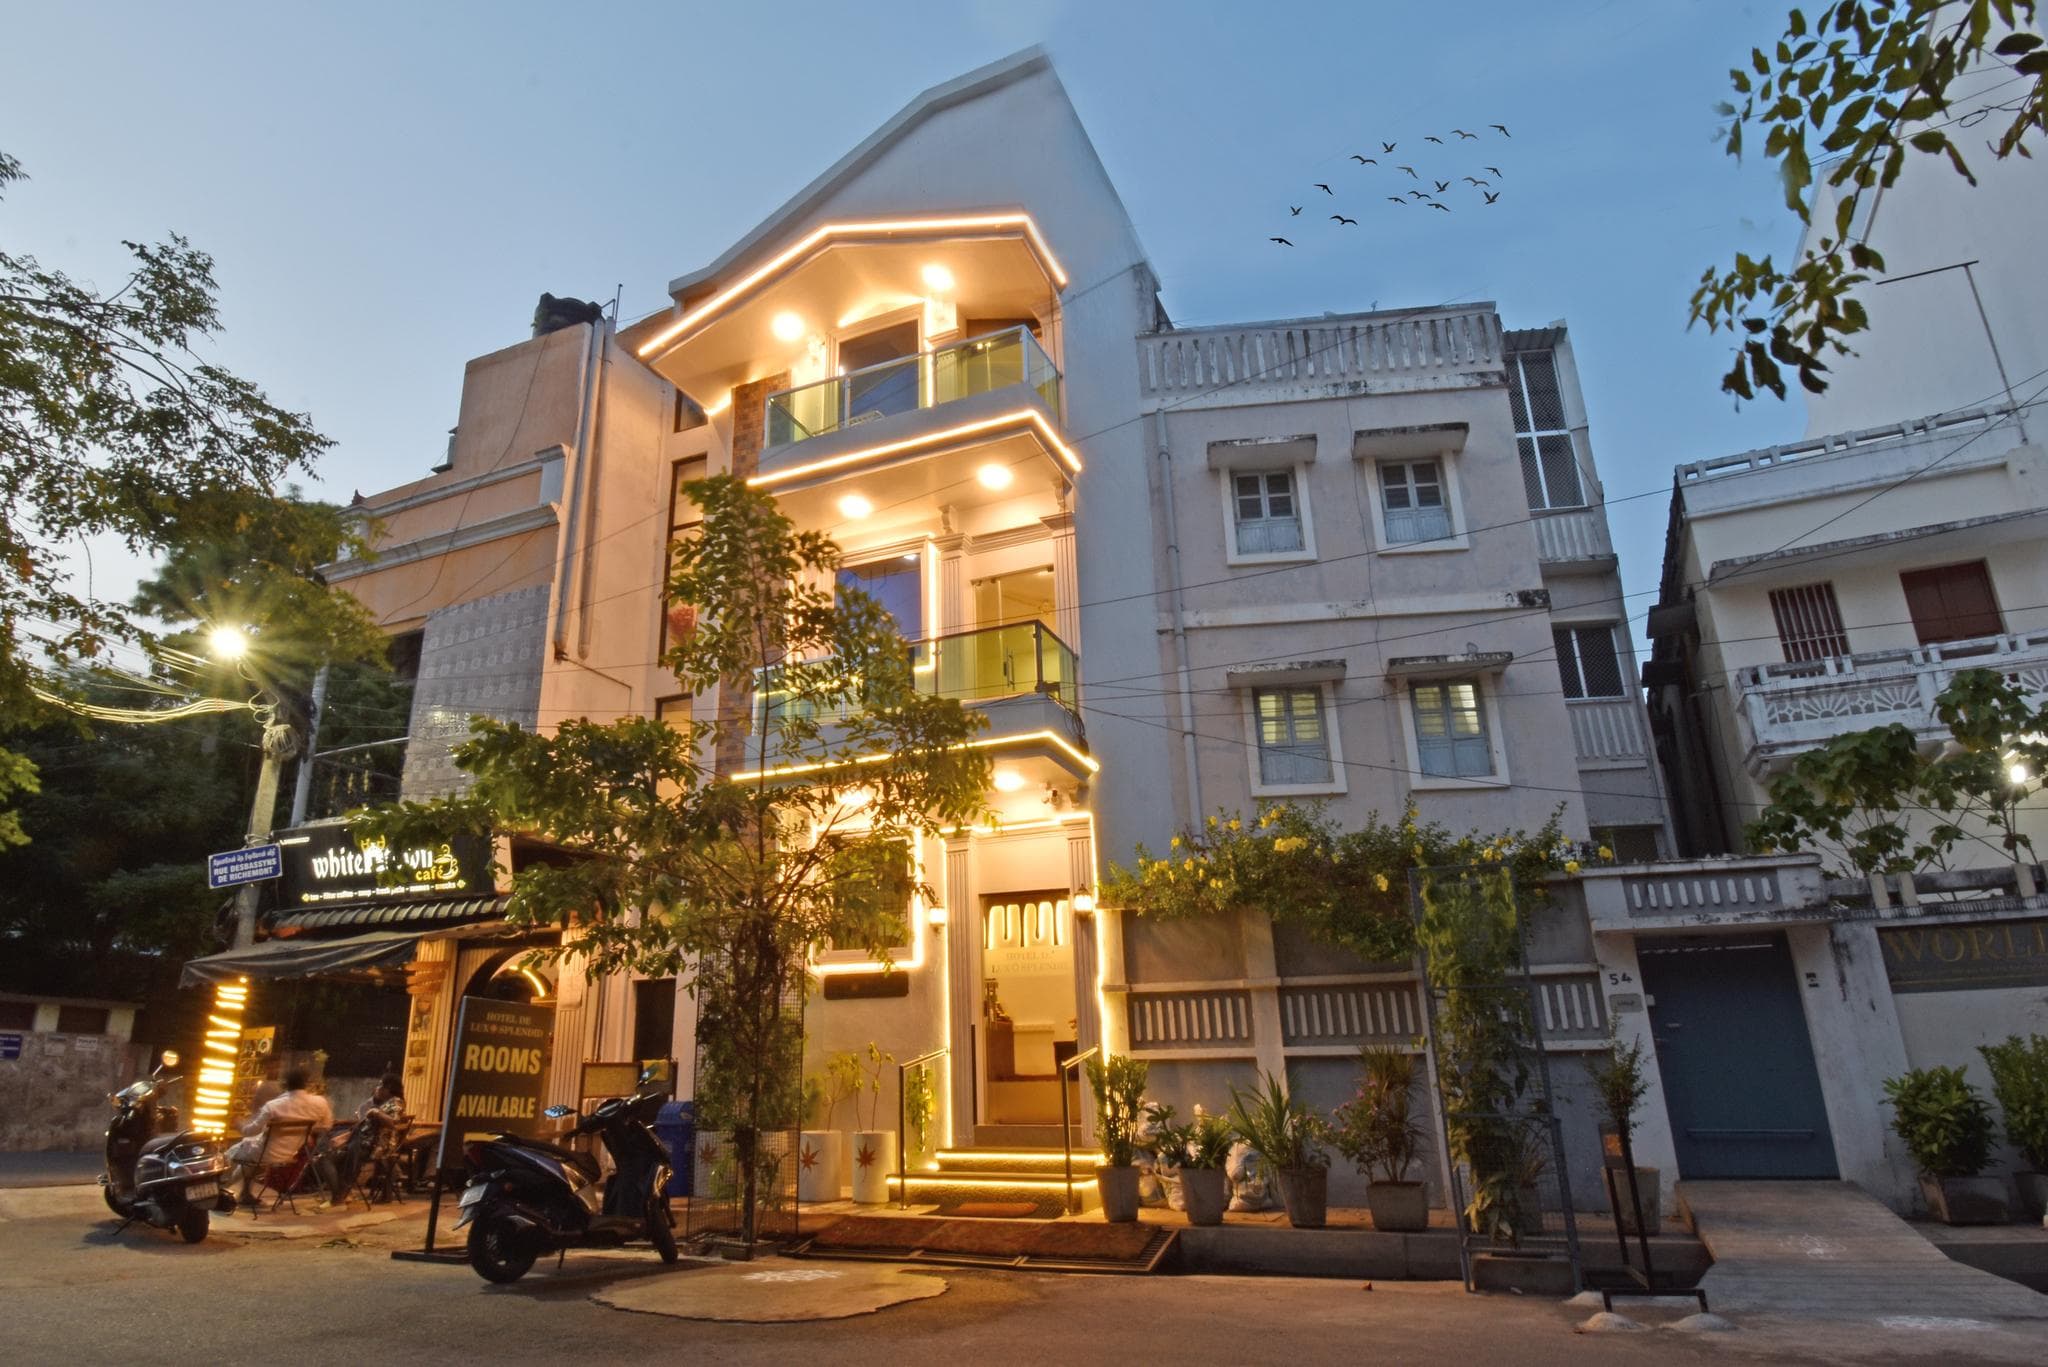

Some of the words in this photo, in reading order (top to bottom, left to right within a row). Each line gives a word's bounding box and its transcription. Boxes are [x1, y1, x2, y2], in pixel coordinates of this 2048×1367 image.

[214, 866, 228, 876] RUE
[312, 846, 364, 879] white
[217, 874, 228, 883] DE
[229, 867, 273, 881] RICHEMONT
[1881, 921, 2048, 962] WORL
[470, 1022, 489, 1033] LUX
[486, 1011, 517, 1024] HOTEL
[519, 1015, 532, 1026] DE
[464, 1044, 542, 1075] ROOMS
[456, 1094, 537, 1119] AVAILABLE
